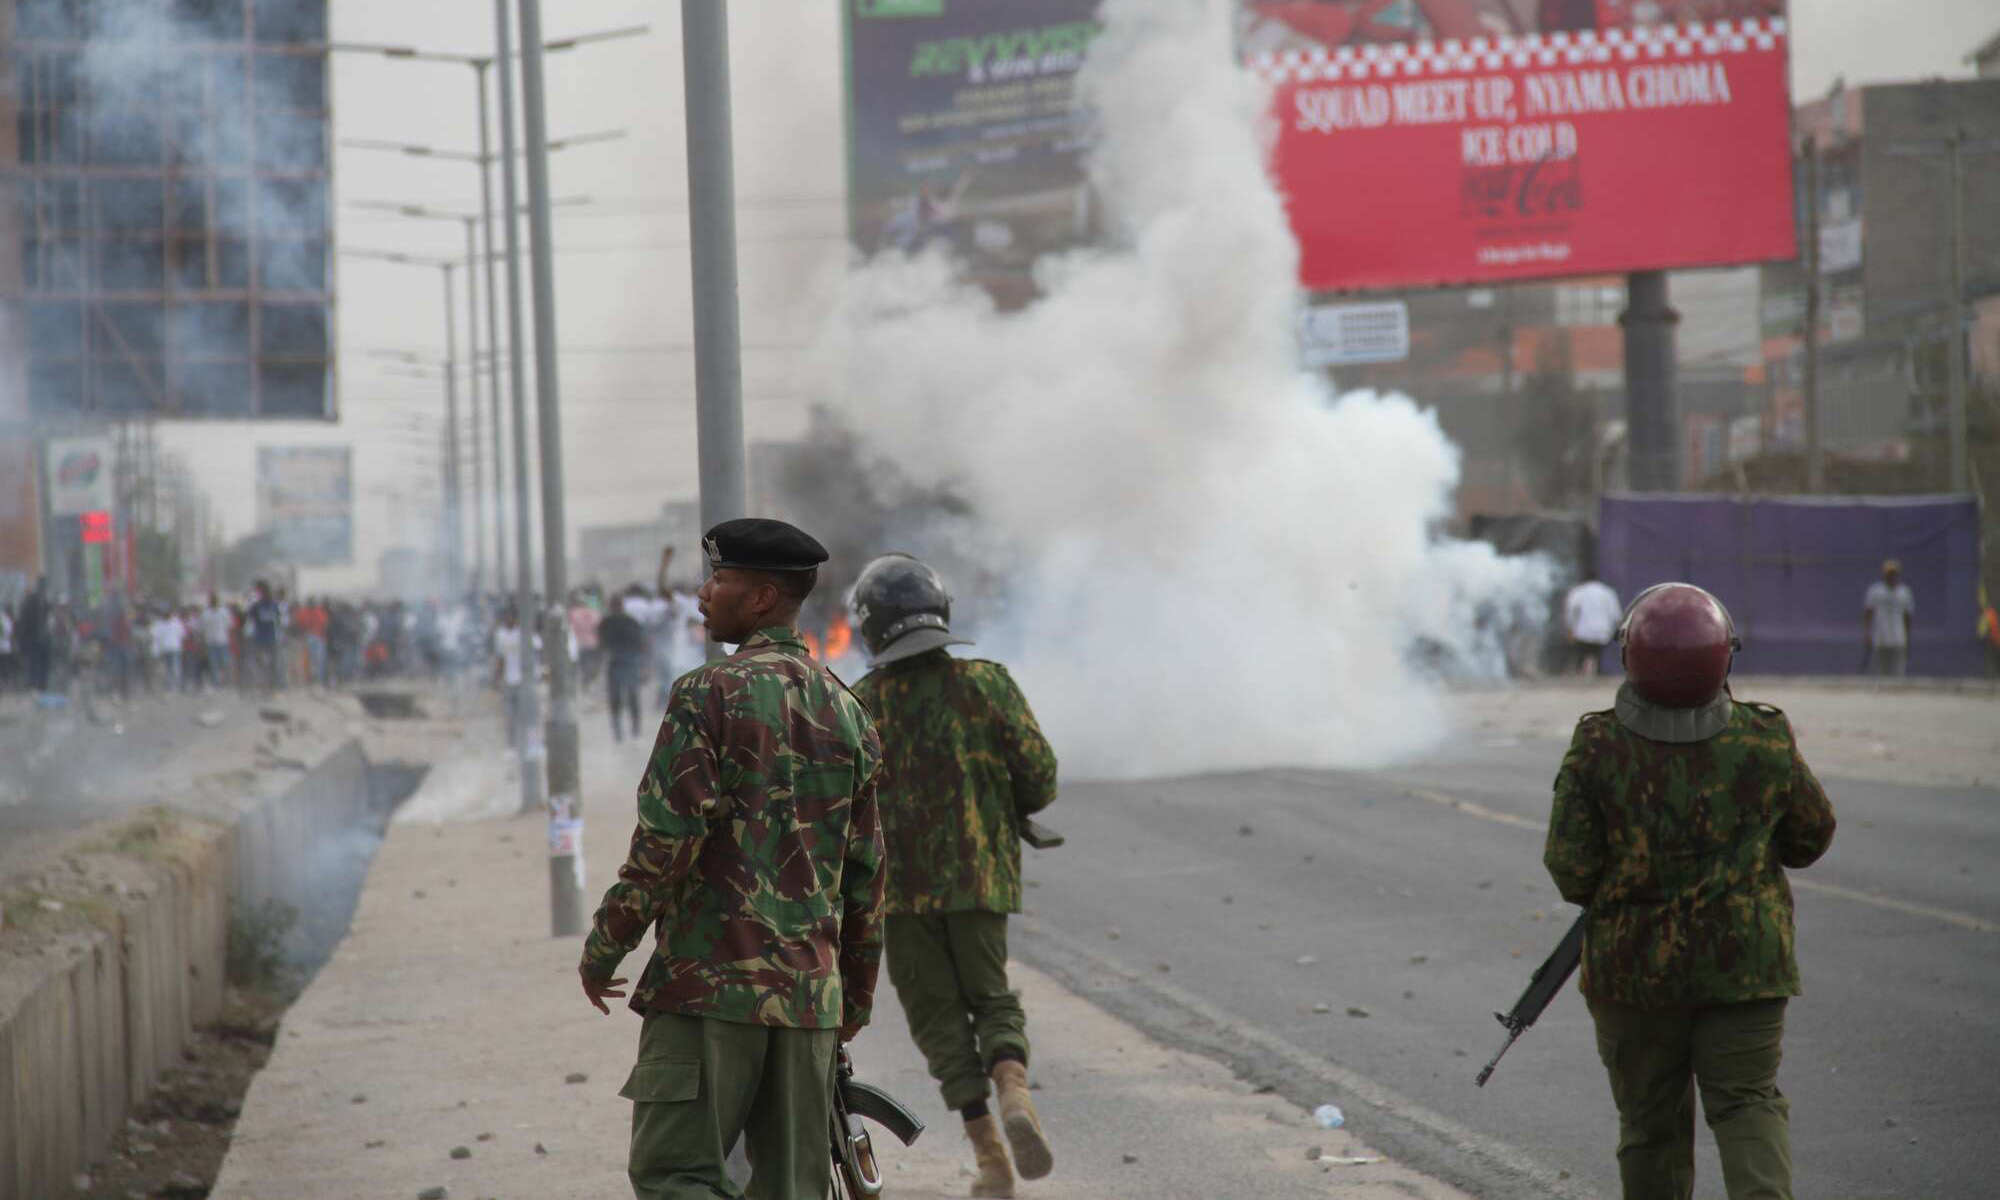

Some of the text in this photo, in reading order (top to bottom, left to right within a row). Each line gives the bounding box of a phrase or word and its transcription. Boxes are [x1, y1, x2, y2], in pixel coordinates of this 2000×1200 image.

[1296, 84, 1390, 133] SQUAD
[1524, 68, 1626, 116] NYAMA
[1627, 60, 1732, 108] CHOMA
[1462, 120, 1577, 166] ICE COLD
